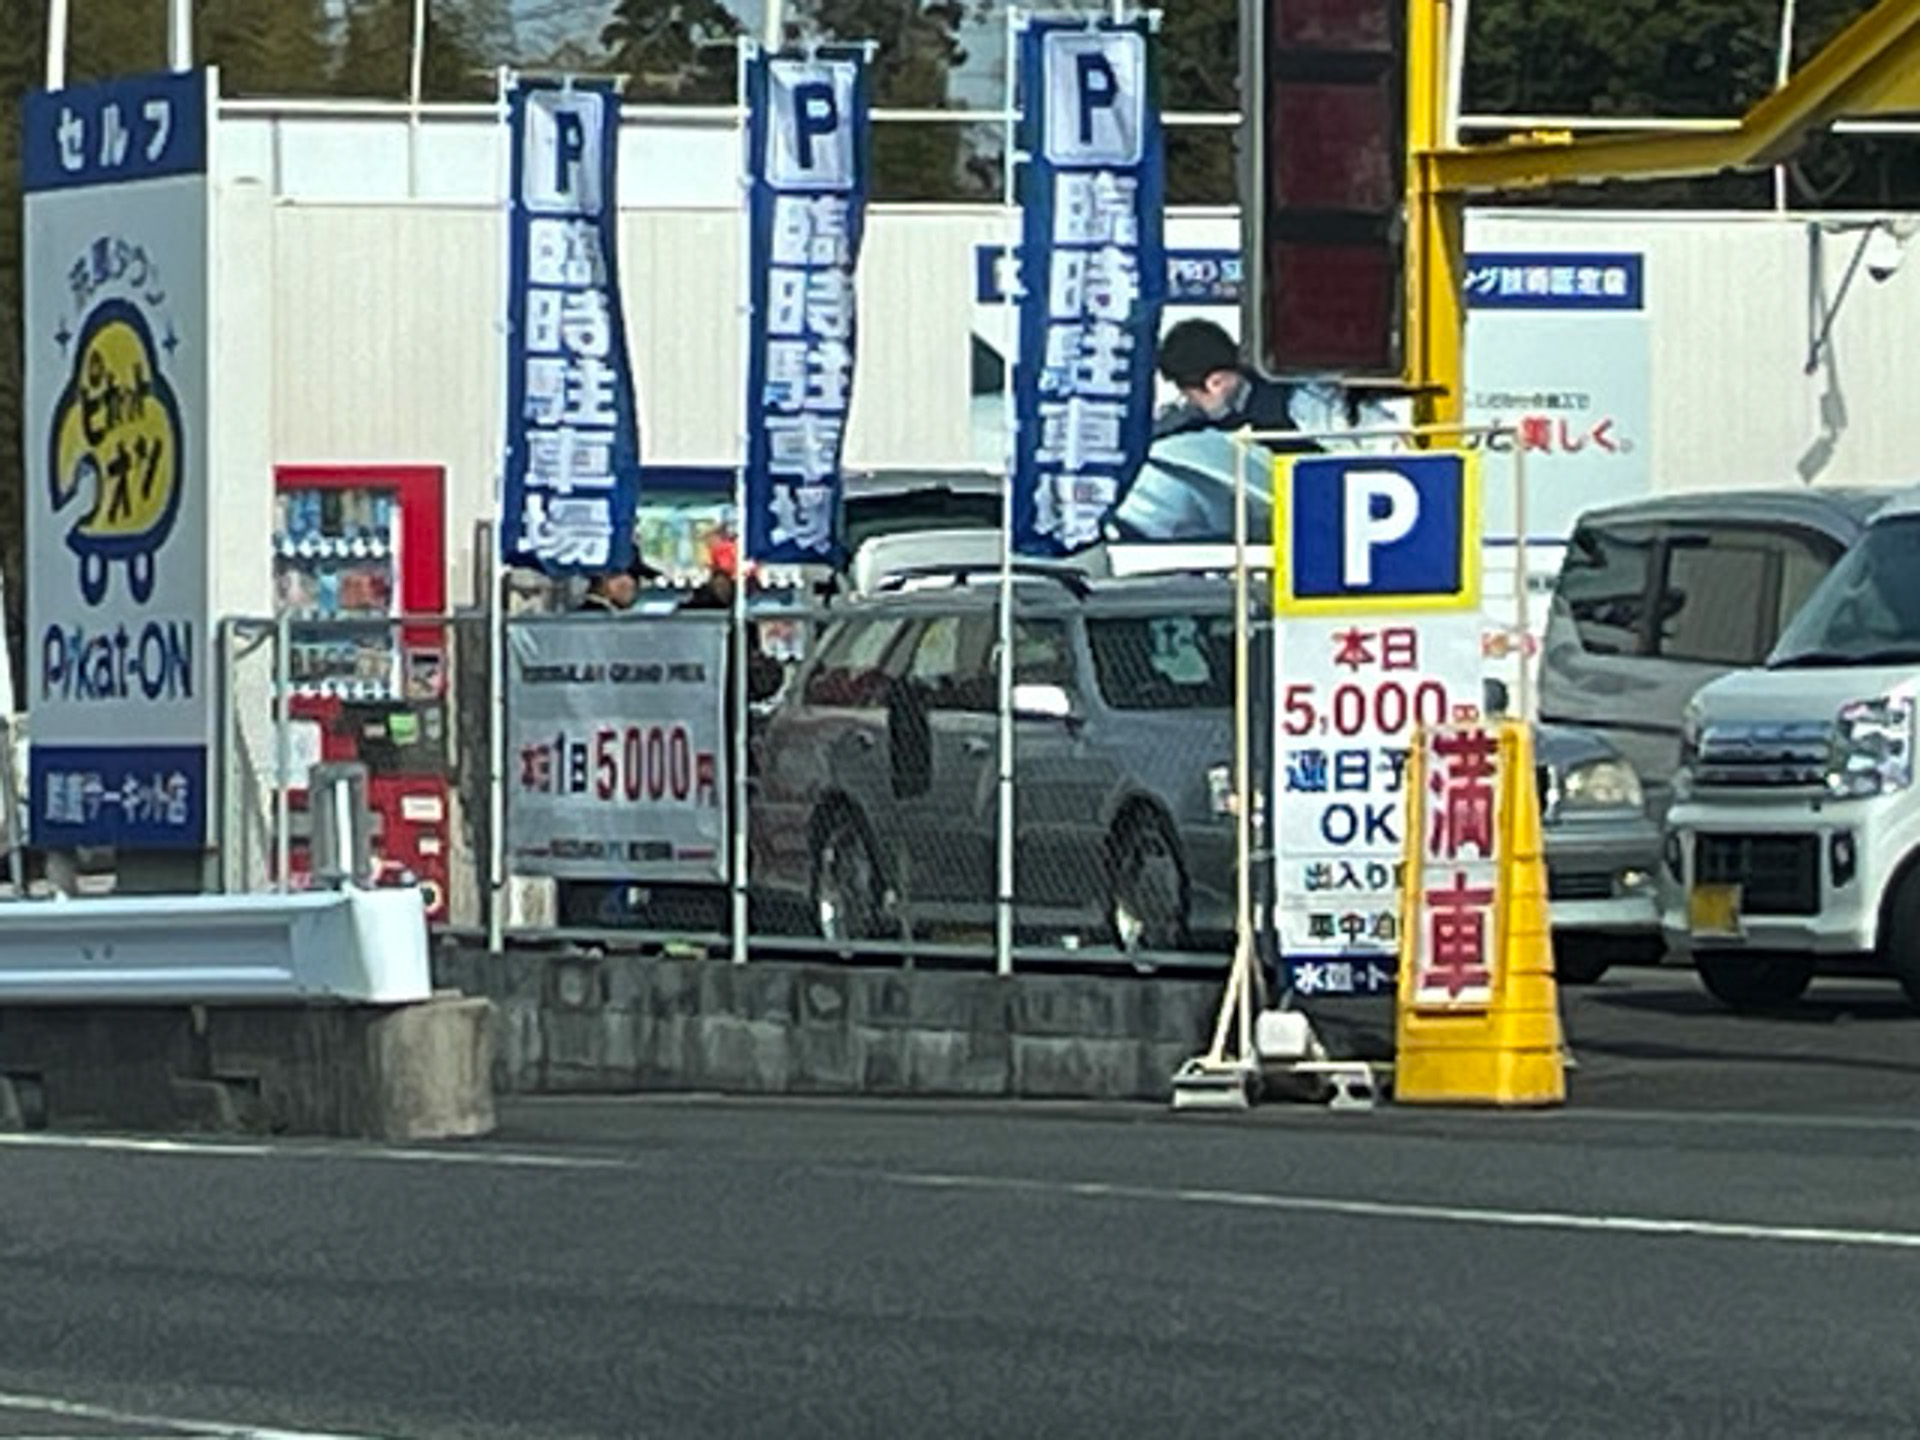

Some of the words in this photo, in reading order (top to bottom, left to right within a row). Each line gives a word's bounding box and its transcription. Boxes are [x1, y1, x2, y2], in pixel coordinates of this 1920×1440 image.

[57, 101, 170, 170] セルフ
[794, 83, 839, 168] P
[1076, 53, 1119, 144] P
[554, 111, 585, 194] P
[518, 217, 618, 565] 臨時駐車場
[764, 194, 854, 553] 臨時駐車場
[1034, 171, 1139, 550] 臨時駐車場
[1344, 470, 1420, 586] P
[43, 621, 192, 700] Pikat-ON
[1332, 626, 1418, 671] 本日
[1321, 803, 1400, 845] OK
[1422, 729, 1498, 999] 満車
